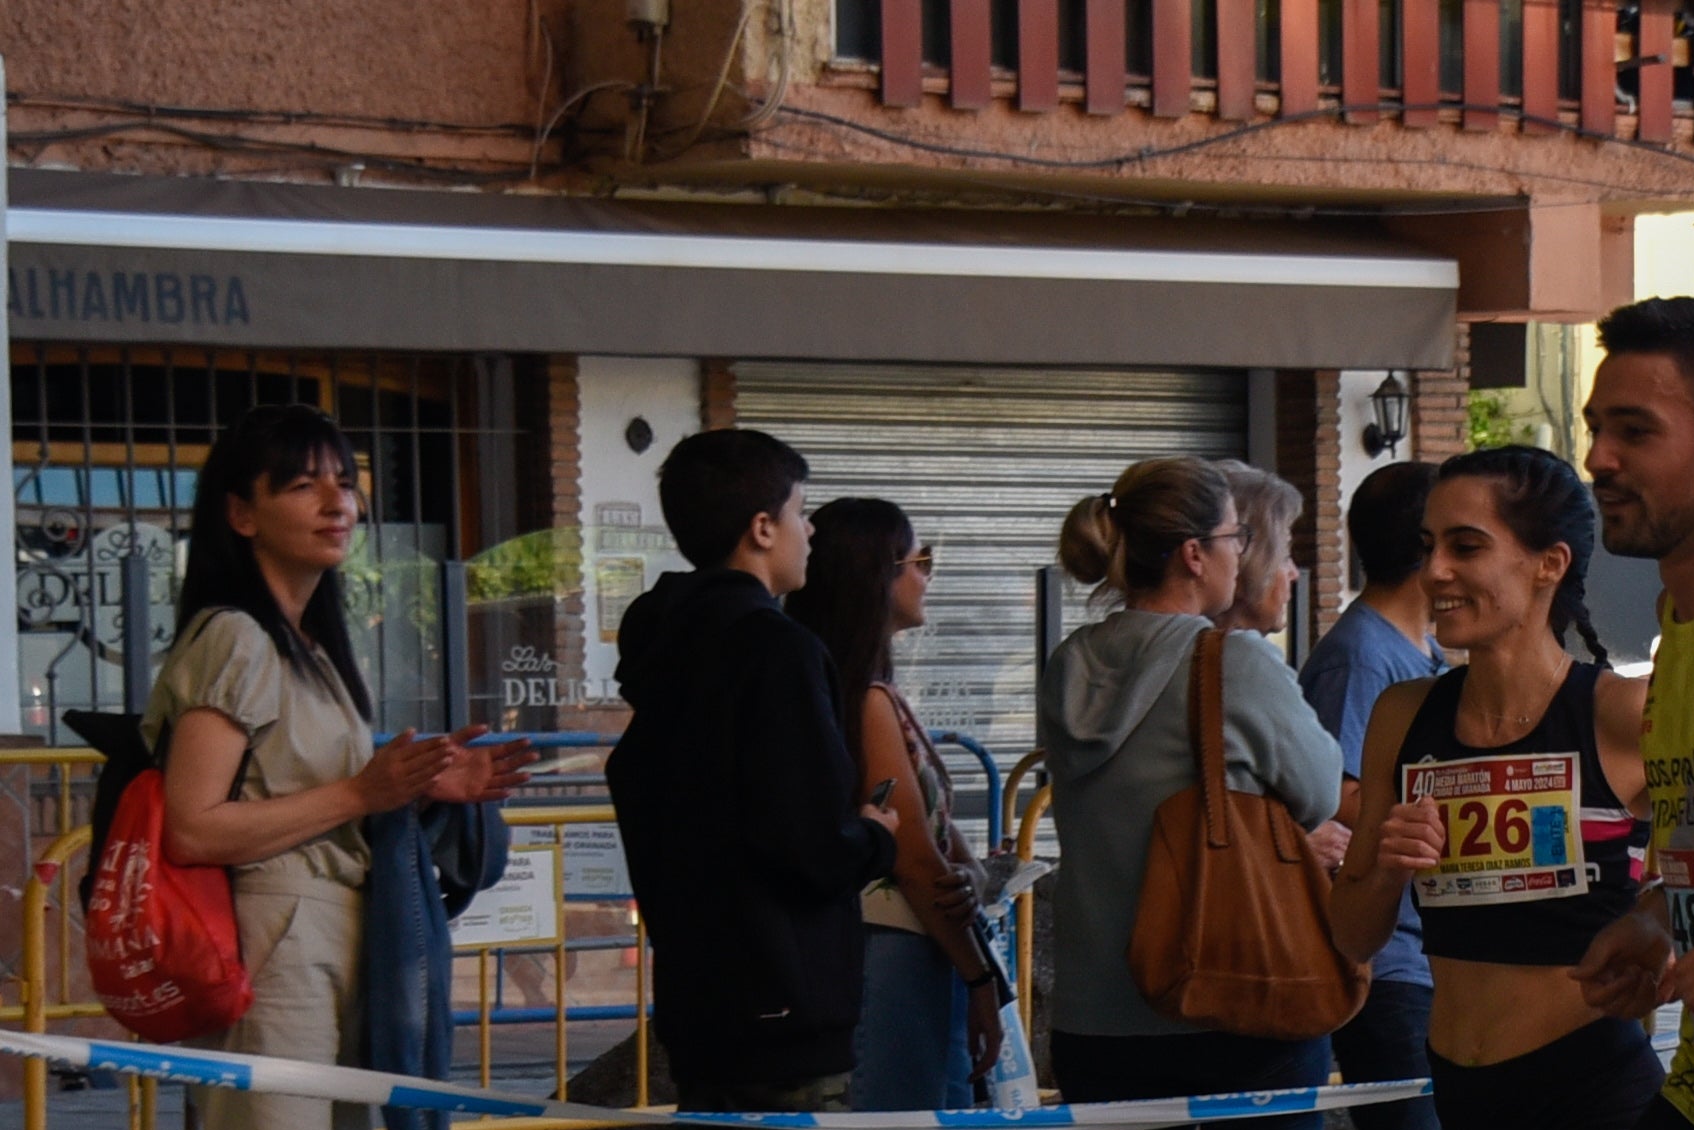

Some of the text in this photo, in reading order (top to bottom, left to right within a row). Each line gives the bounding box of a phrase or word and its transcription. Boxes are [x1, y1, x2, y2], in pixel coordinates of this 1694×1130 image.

[1411, 770, 1435, 796] 40
[1504, 775, 1554, 792] 4 MAYO 2024
